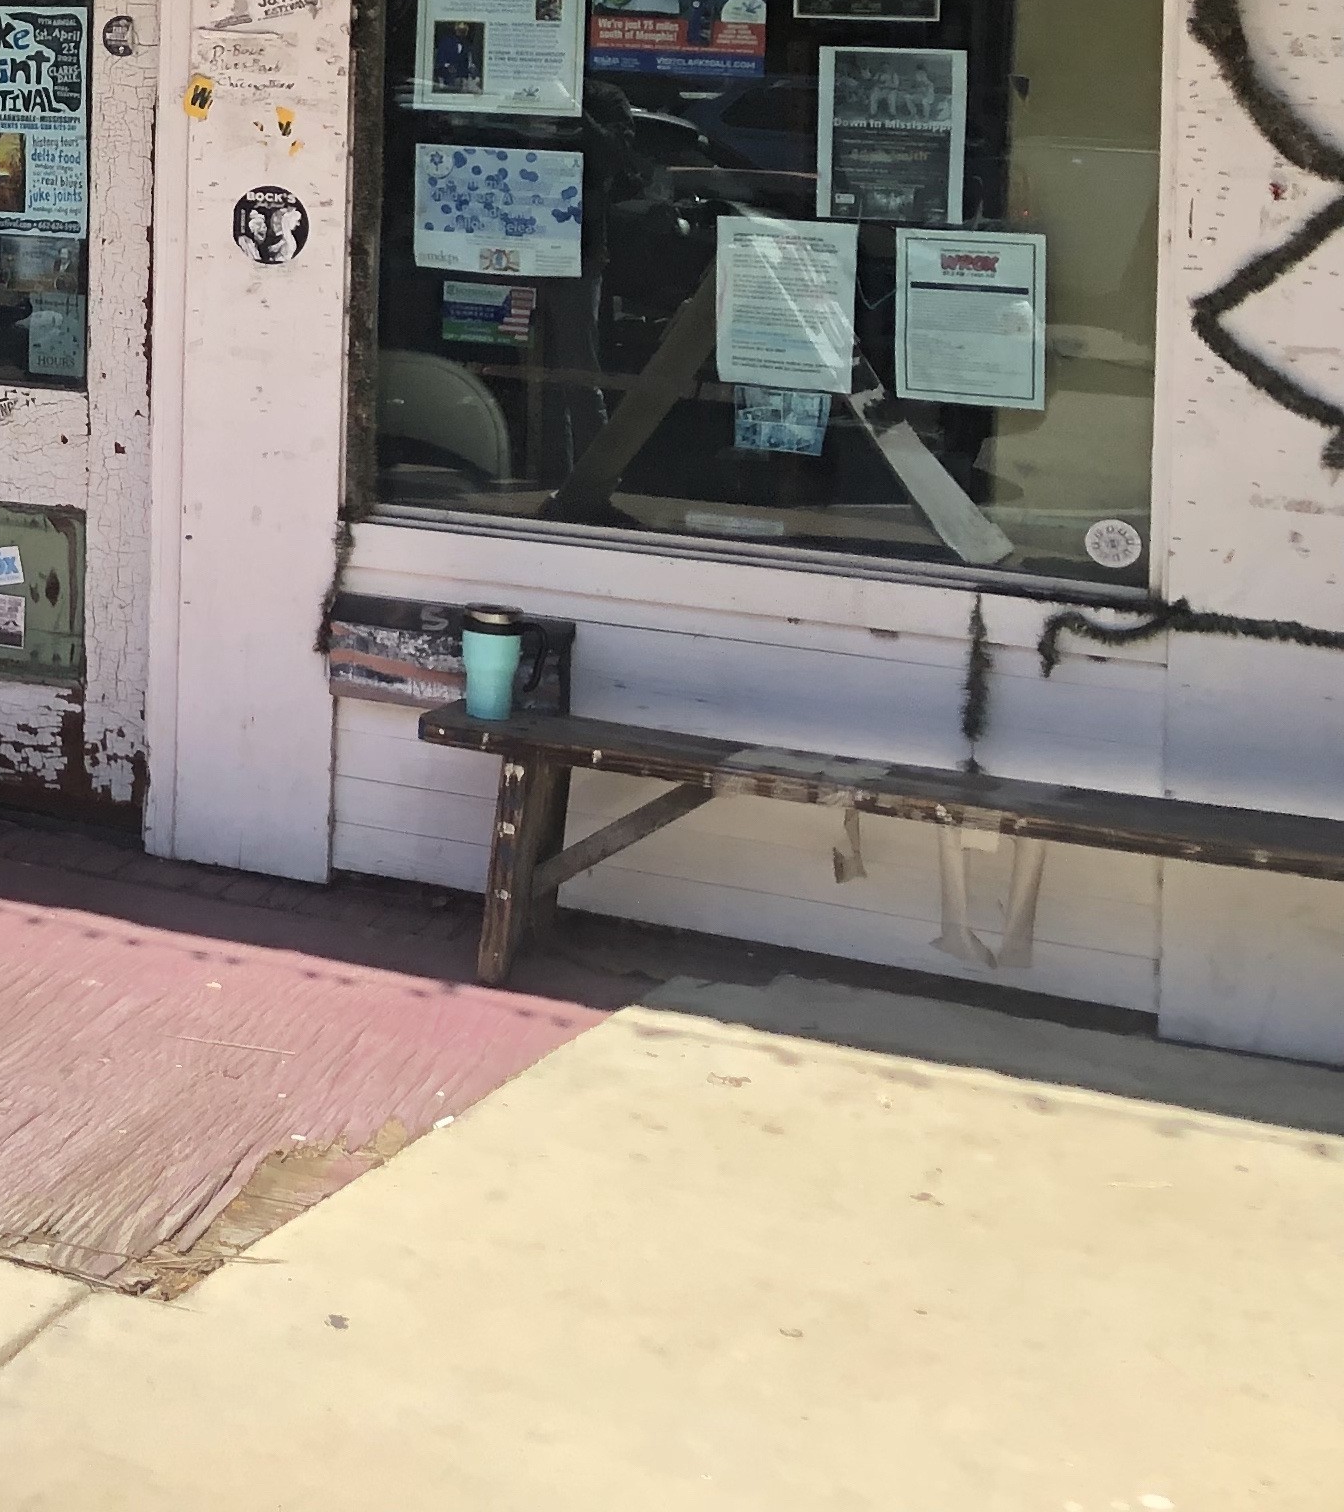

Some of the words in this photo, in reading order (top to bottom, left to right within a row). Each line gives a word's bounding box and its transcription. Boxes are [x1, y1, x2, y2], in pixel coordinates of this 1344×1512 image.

[53, 27, 80, 41] April
[833, 117, 866, 128] Down
[885, 119, 953, 133] Mississippi
[31, 148, 56, 163] delta
[58, 149, 81, 165] food
[41, 175, 58, 187] real
[28, 189, 51, 208] juke
[52, 188, 83, 206] joints
[246, 190, 298, 205] BOCK'S
[940, 253, 1000, 274] WROX
[37, 355, 76, 368] HOURS
